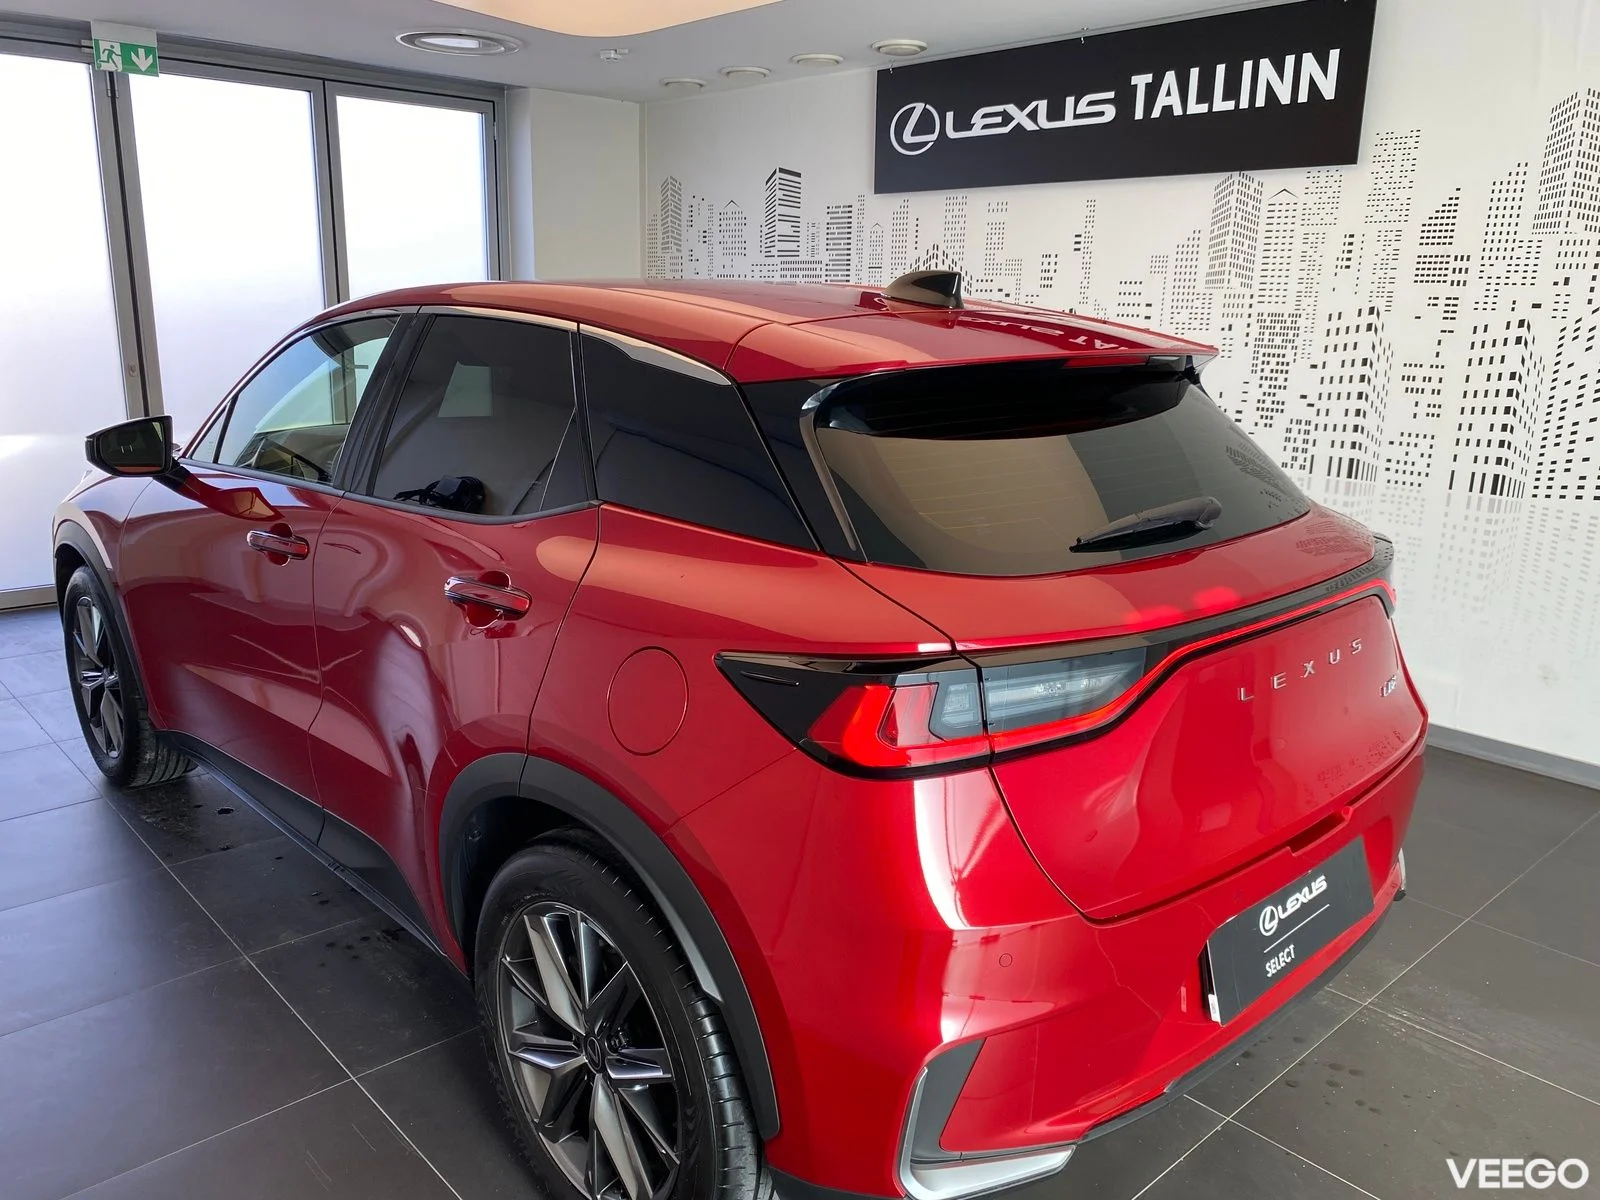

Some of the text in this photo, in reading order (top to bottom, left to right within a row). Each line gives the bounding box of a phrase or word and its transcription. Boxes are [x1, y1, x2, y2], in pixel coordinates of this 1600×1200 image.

[945, 49, 1340, 138] LEXUS TALLINN
[1239, 639, 1362, 701] LEXUS
[1278, 876, 1327, 919] LEXUS
[1265, 945, 1295, 977] SELECT
